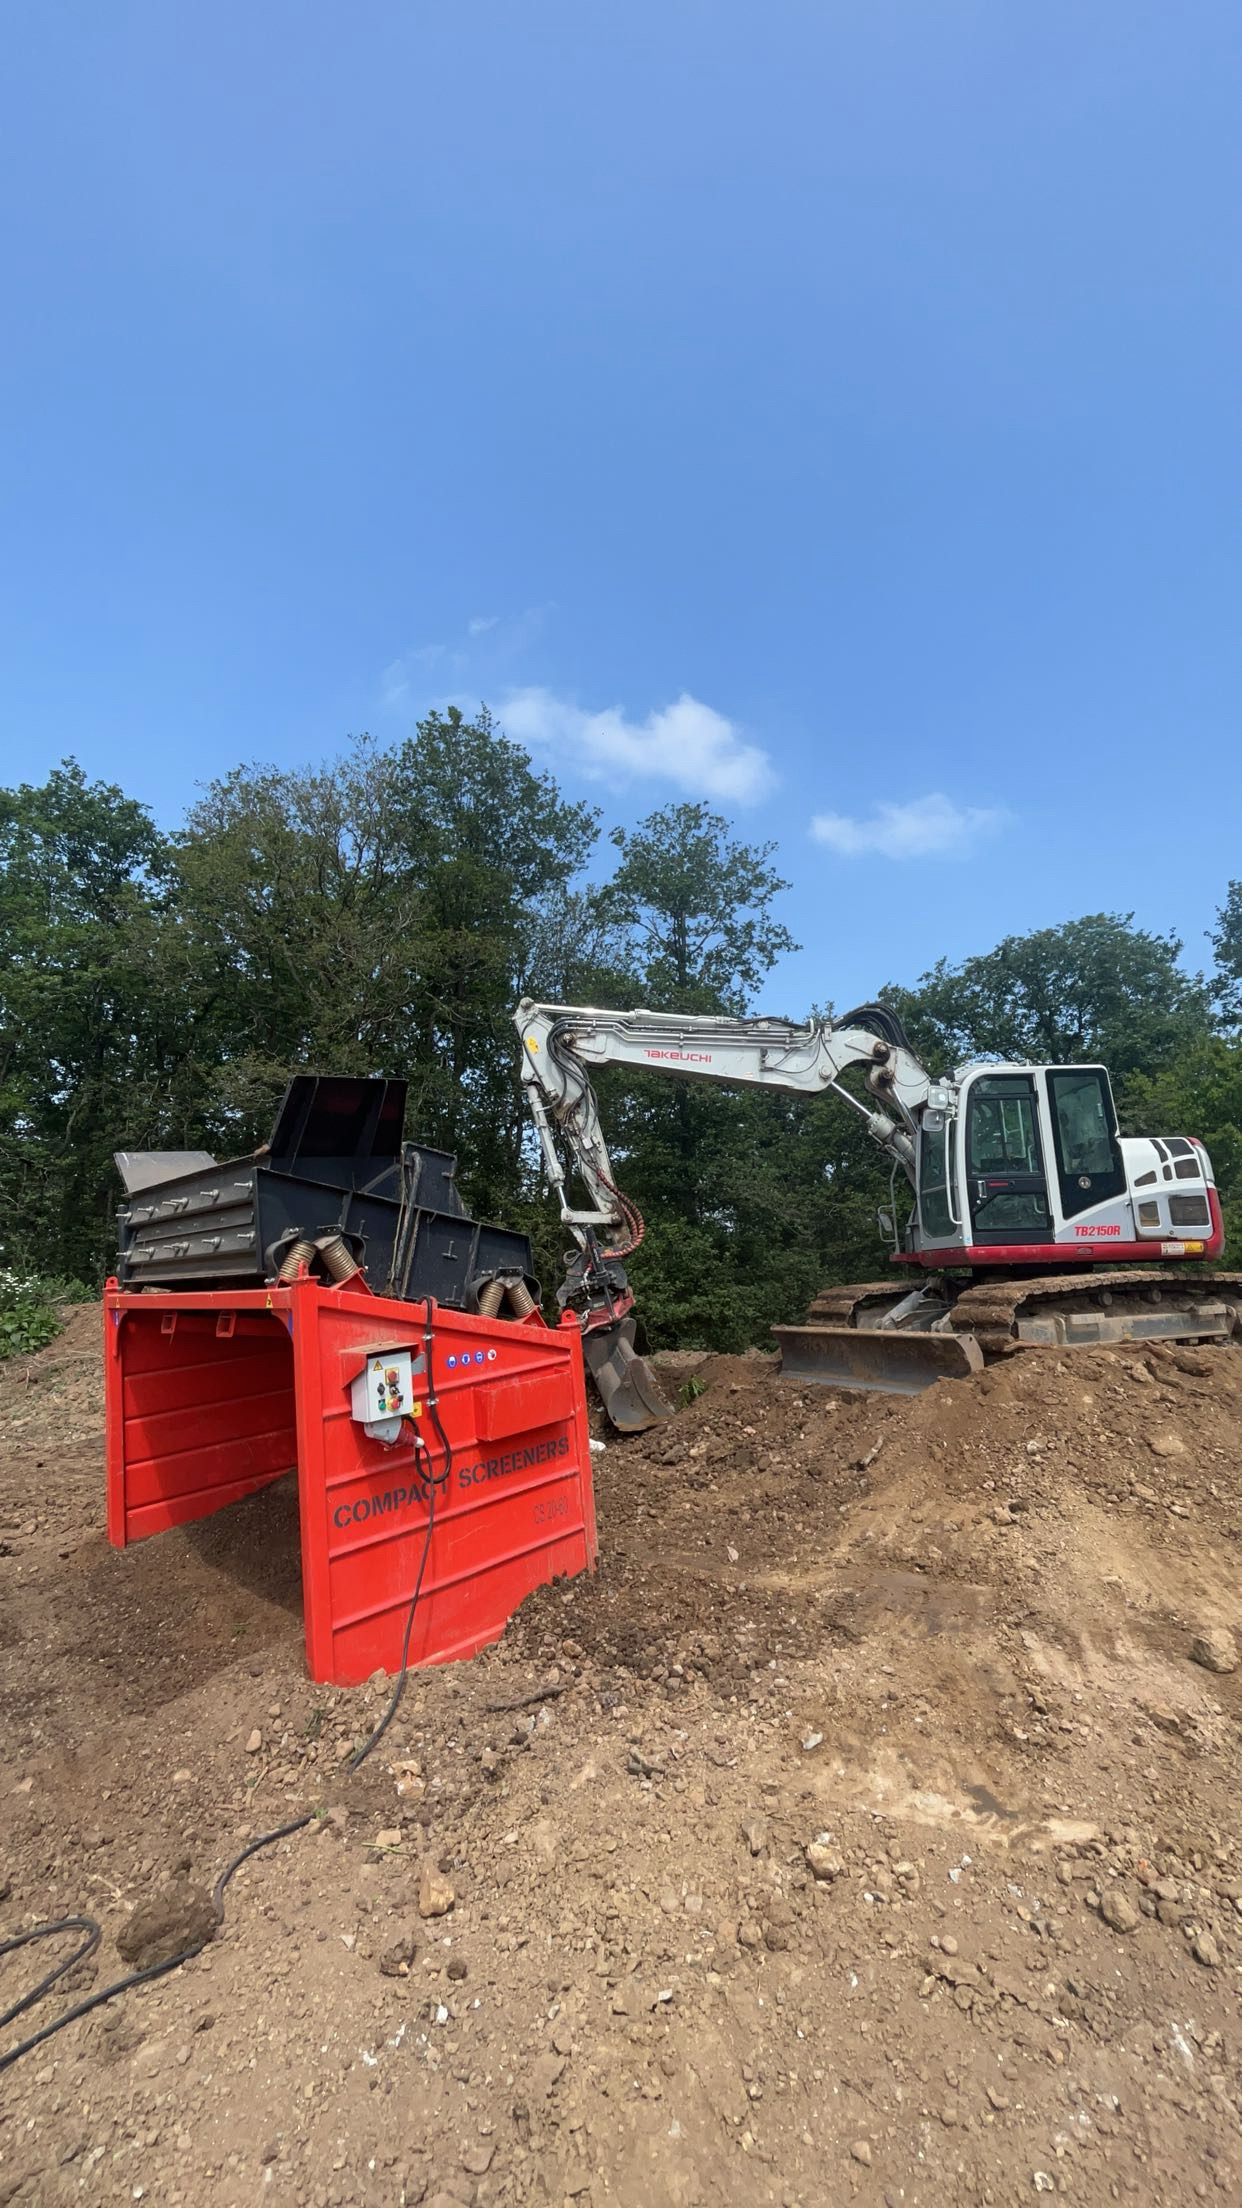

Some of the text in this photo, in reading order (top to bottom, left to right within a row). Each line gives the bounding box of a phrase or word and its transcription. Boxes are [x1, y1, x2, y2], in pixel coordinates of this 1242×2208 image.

[643, 1049, 712, 1063] TAKEUCHI
[1074, 1225, 1121, 1237] TB2150R
[458, 1435, 569, 1488] SCREENERS
